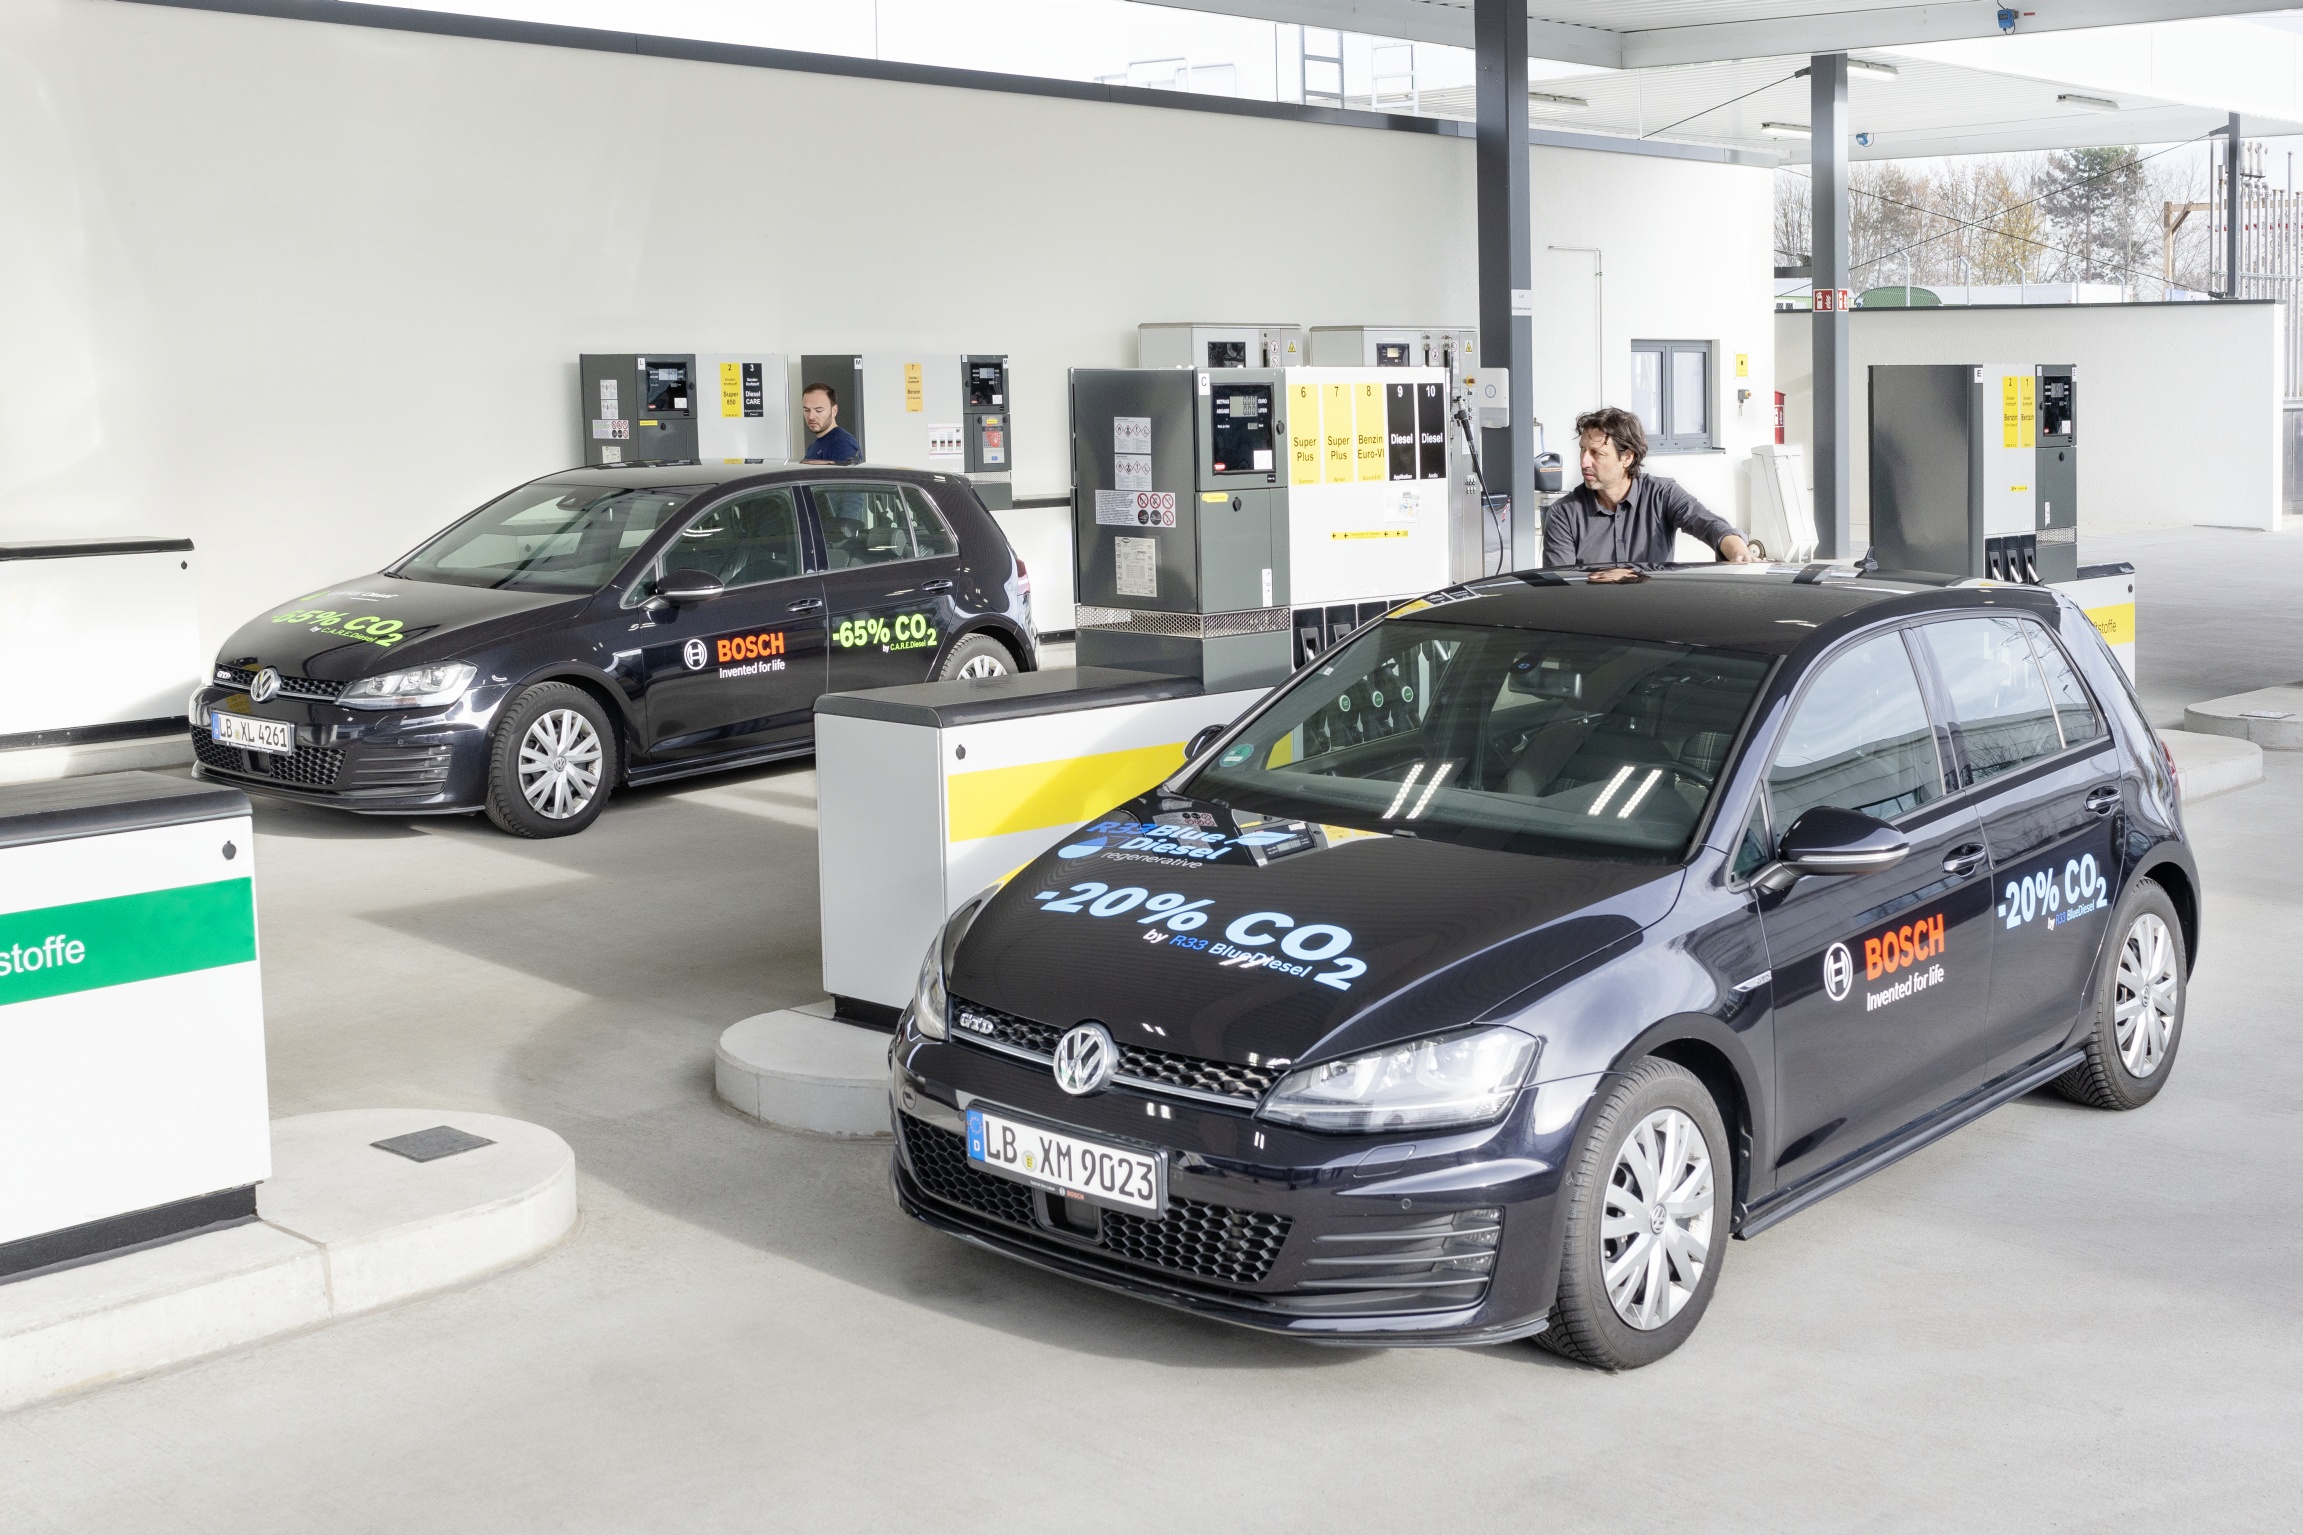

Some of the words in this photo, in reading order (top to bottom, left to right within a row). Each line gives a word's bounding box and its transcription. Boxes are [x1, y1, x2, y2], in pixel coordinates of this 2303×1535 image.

[1201, 376, 1207, 386] C
[2009, 378, 2012, 386] 2
[1301, 386, 1306, 398] 6
[1334, 386, 1339, 397] 7
[1366, 385, 1371, 397] 8
[1397, 385, 1403, 397] 9
[1426, 385, 1436, 397] 10
[1294, 437, 1316, 449] Super
[1327, 436, 1349, 447] Super
[1358, 434, 1383, 445] Benzin
[1390, 433, 1413, 445] Diesel
[1422, 433, 1443, 443] Diesel
[1297, 452, 1314, 462] Plus
[1331, 451, 1347, 460] Plus
[1358, 449, 1384, 459] Euro-VI
[271, 610, 350, 626] -65%
[832, 618, 890, 647] -65%
[717, 632, 784, 662] BOSCH
[882, 644, 889, 653] by
[720, 662, 757, 679] Invented
[758, 661, 771, 672] for
[772, 659, 785, 671] life
[220, 718, 232, 738] LB
[241, 721, 255, 742] XL
[259, 724, 287, 747] 4261
[1118, 836, 1233, 860] Diesel
[1101, 850, 1203, 869] regenerative
[1998, 868, 2059, 929] -20%
[1034, 882, 1215, 931] -20%
[2048, 917, 2055, 930] by
[2056, 912, 2066, 925] R33
[2066, 899, 2095, 921] BlueDiesel
[1143, 928, 1169, 944] by
[1169, 934, 1208, 950] R33
[1208, 942, 1313, 978] BlueDiesel
[1864, 914, 1944, 981] BOSCH
[1866, 975, 1912, 1012] Invented
[1914, 972, 1928, 992] for
[1929, 964, 1944, 986] life
[960, 1012, 994, 1034] GTD
[974, 1140, 980, 1151] D
[986, 1120, 1018, 1164] LB
[1039, 1136, 1073, 1182] XM
[1081, 1149, 1153, 1201] 9023
[1066, 1190, 1084, 1200] BOSCH
